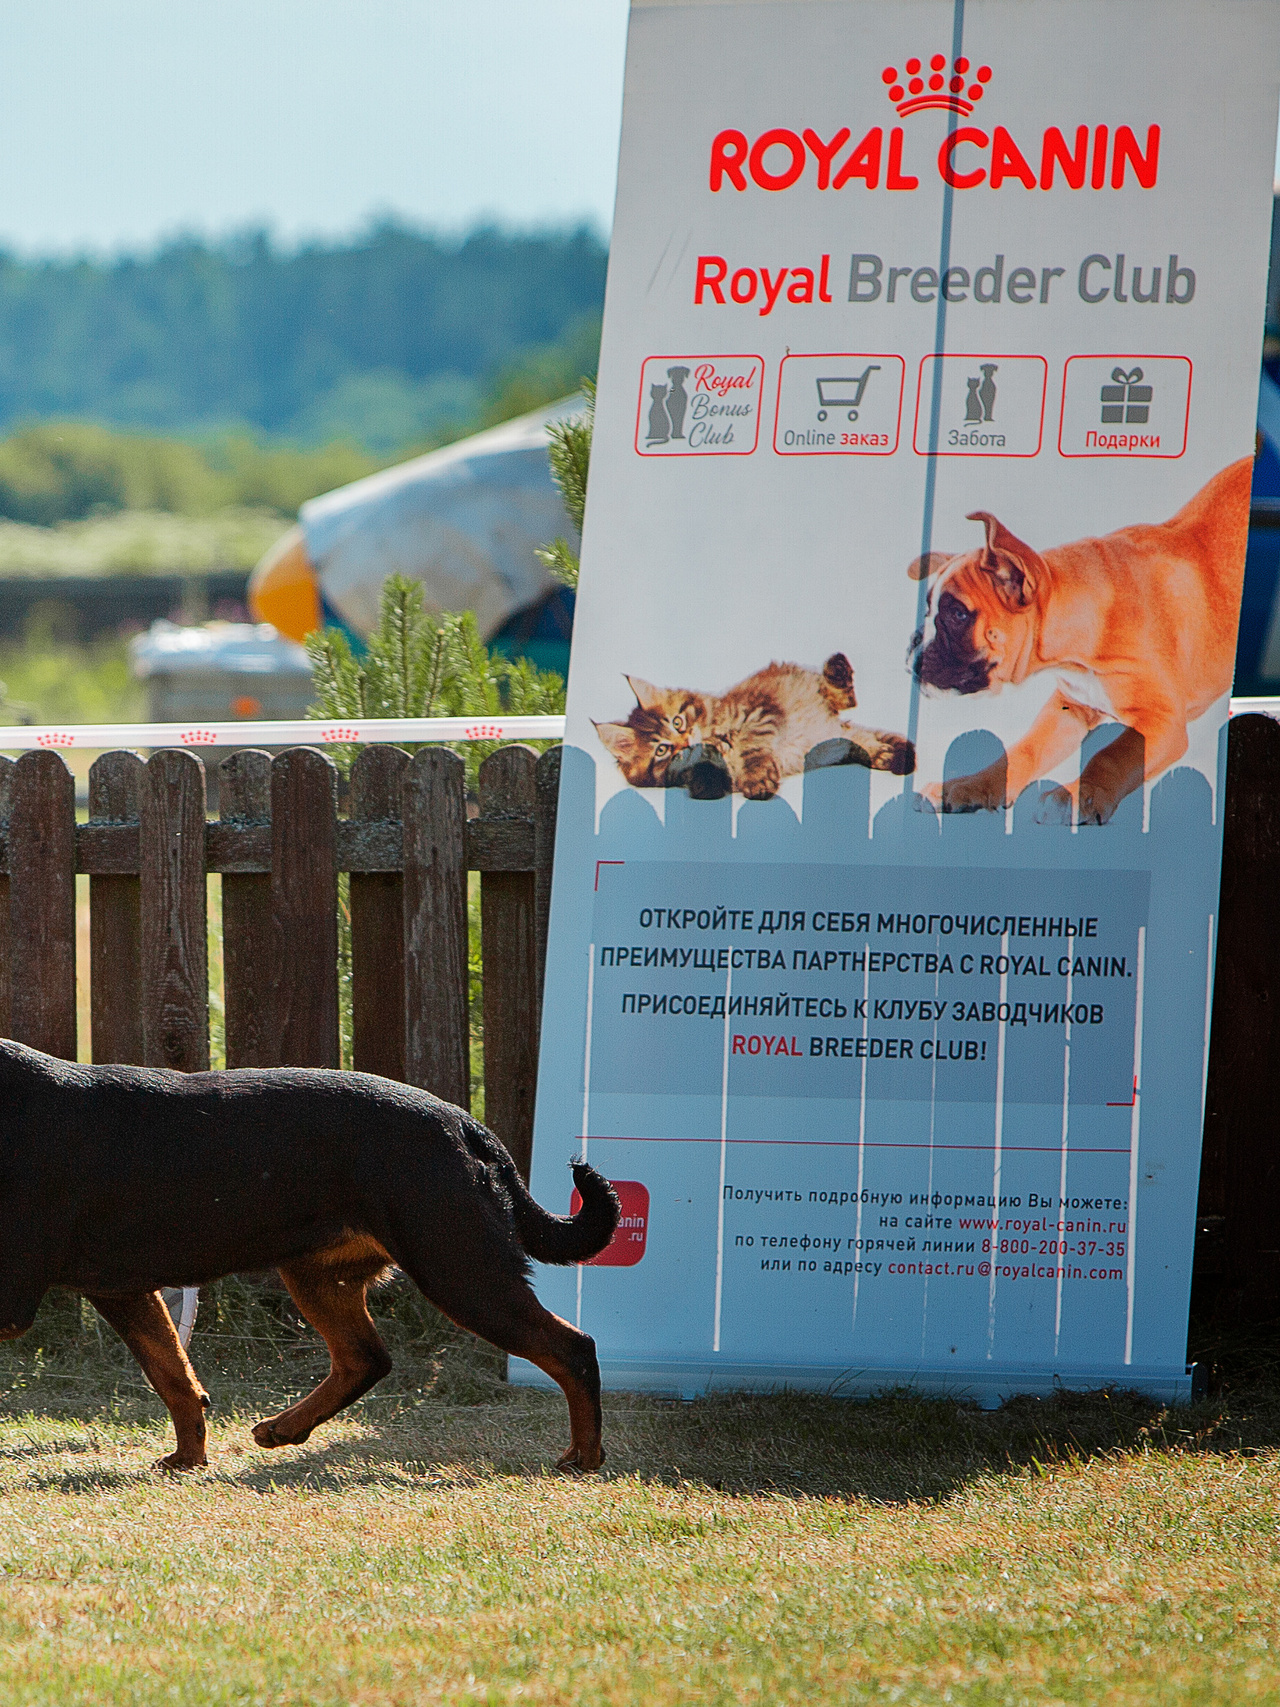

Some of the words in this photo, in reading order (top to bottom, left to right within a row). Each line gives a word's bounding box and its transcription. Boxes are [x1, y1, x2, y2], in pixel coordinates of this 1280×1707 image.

[709, 126, 919, 192] ROYAL
[938, 124, 1161, 191] CANIN
[693, 255, 833, 316] Royal
[848, 253, 1066, 305] Breeder
[1078, 254, 1197, 305] Club
[694, 363, 757, 397] Royal
[690, 393, 753, 420] Bonus
[688, 422, 736, 448] Club
[784, 429, 835, 446] Online
[840, 433, 889, 446] заказ
[948, 429, 1006, 447] Забота
[1086, 431, 1160, 451] Подарки
[639, 905, 754, 930] ОТКРОЙТЕ
[758, 911, 806, 934] ДЛЯ
[812, 912, 871, 932] СЕБЯ
[877, 913, 1099, 937] МНОГОЧИСЛЕННЫЕ
[600, 947, 786, 972] ПРЕИМУЩЕСТВА
[792, 950, 954, 974] ПАРТНЕРСТВА
[960, 954, 974, 975] С
[980, 955, 1051, 976] ROYAL
[1057, 956, 1133, 977] CANIN.
[621, 992, 847, 1020] ПРИСОЕДИНЯЙТЕСЬ
[853, 999, 868, 1019] К
[873, 1000, 948, 1021] КЛУБУ
[952, 1002, 1104, 1027] ЗАВОДЧИКОВ
[732, 1034, 803, 1057] ROYAL
[810, 1036, 914, 1060] BREEDER
[920, 1039, 987, 1061] CLUB!
[723, 1185, 802, 1204] Получить
[809, 1188, 903, 1207] подробную
[909, 1191, 1022, 1210] информацию
[1028, 1193, 1052, 1208] Вы
[1059, 1197, 1128, 1211] можете:
[617, 1213, 645, 1228] anin
[879, 1216, 898, 1228] на
[905, 1213, 953, 1229] сайте
[959, 1216, 1126, 1234] www.royal-canin.ru
[735, 1235, 754, 1247] по
[761, 1233, 841, 1252] телефону
[847, 1236, 916, 1253] горячей
[922, 1240, 975, 1252] линии
[981, 1238, 1125, 1257] 8-800-200-37-35
[761, 1259, 791, 1271] или
[798, 1259, 817, 1271] по
[823, 1261, 882, 1277] адресу
